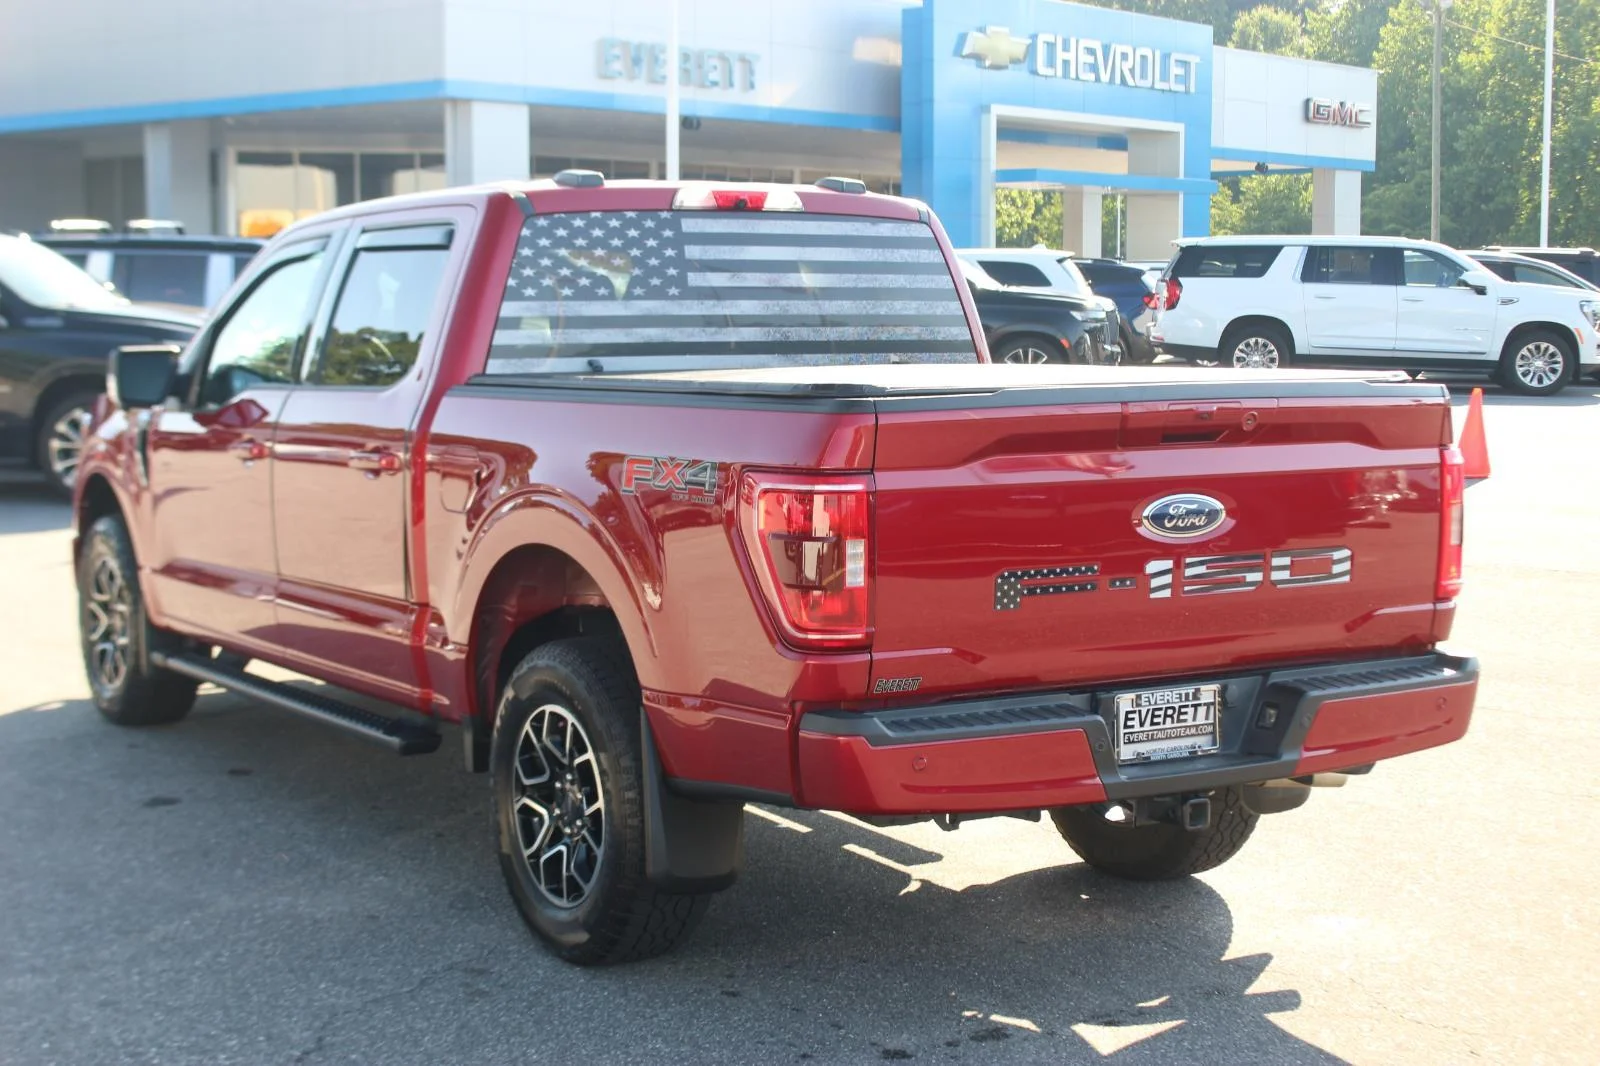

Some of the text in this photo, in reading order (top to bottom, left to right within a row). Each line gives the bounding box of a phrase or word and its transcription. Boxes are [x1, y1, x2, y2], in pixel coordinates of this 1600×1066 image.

[595, 37, 760, 92] EVERETT
[1035, 32, 1202, 94] CHEVROLET
[1305, 97, 1371, 127] GMC
[621, 455, 719, 496] FX4
[1164, 503, 1208, 528] Ford
[994, 547, 1352, 611] F-150
[874, 676, 922, 694] EVERETT
[1141, 689, 1195, 706] EVERETT
[1123, 703, 1214, 730] EVERETT
[1124, 725, 1214, 743] EVERETTAUTOTEAM.COM
